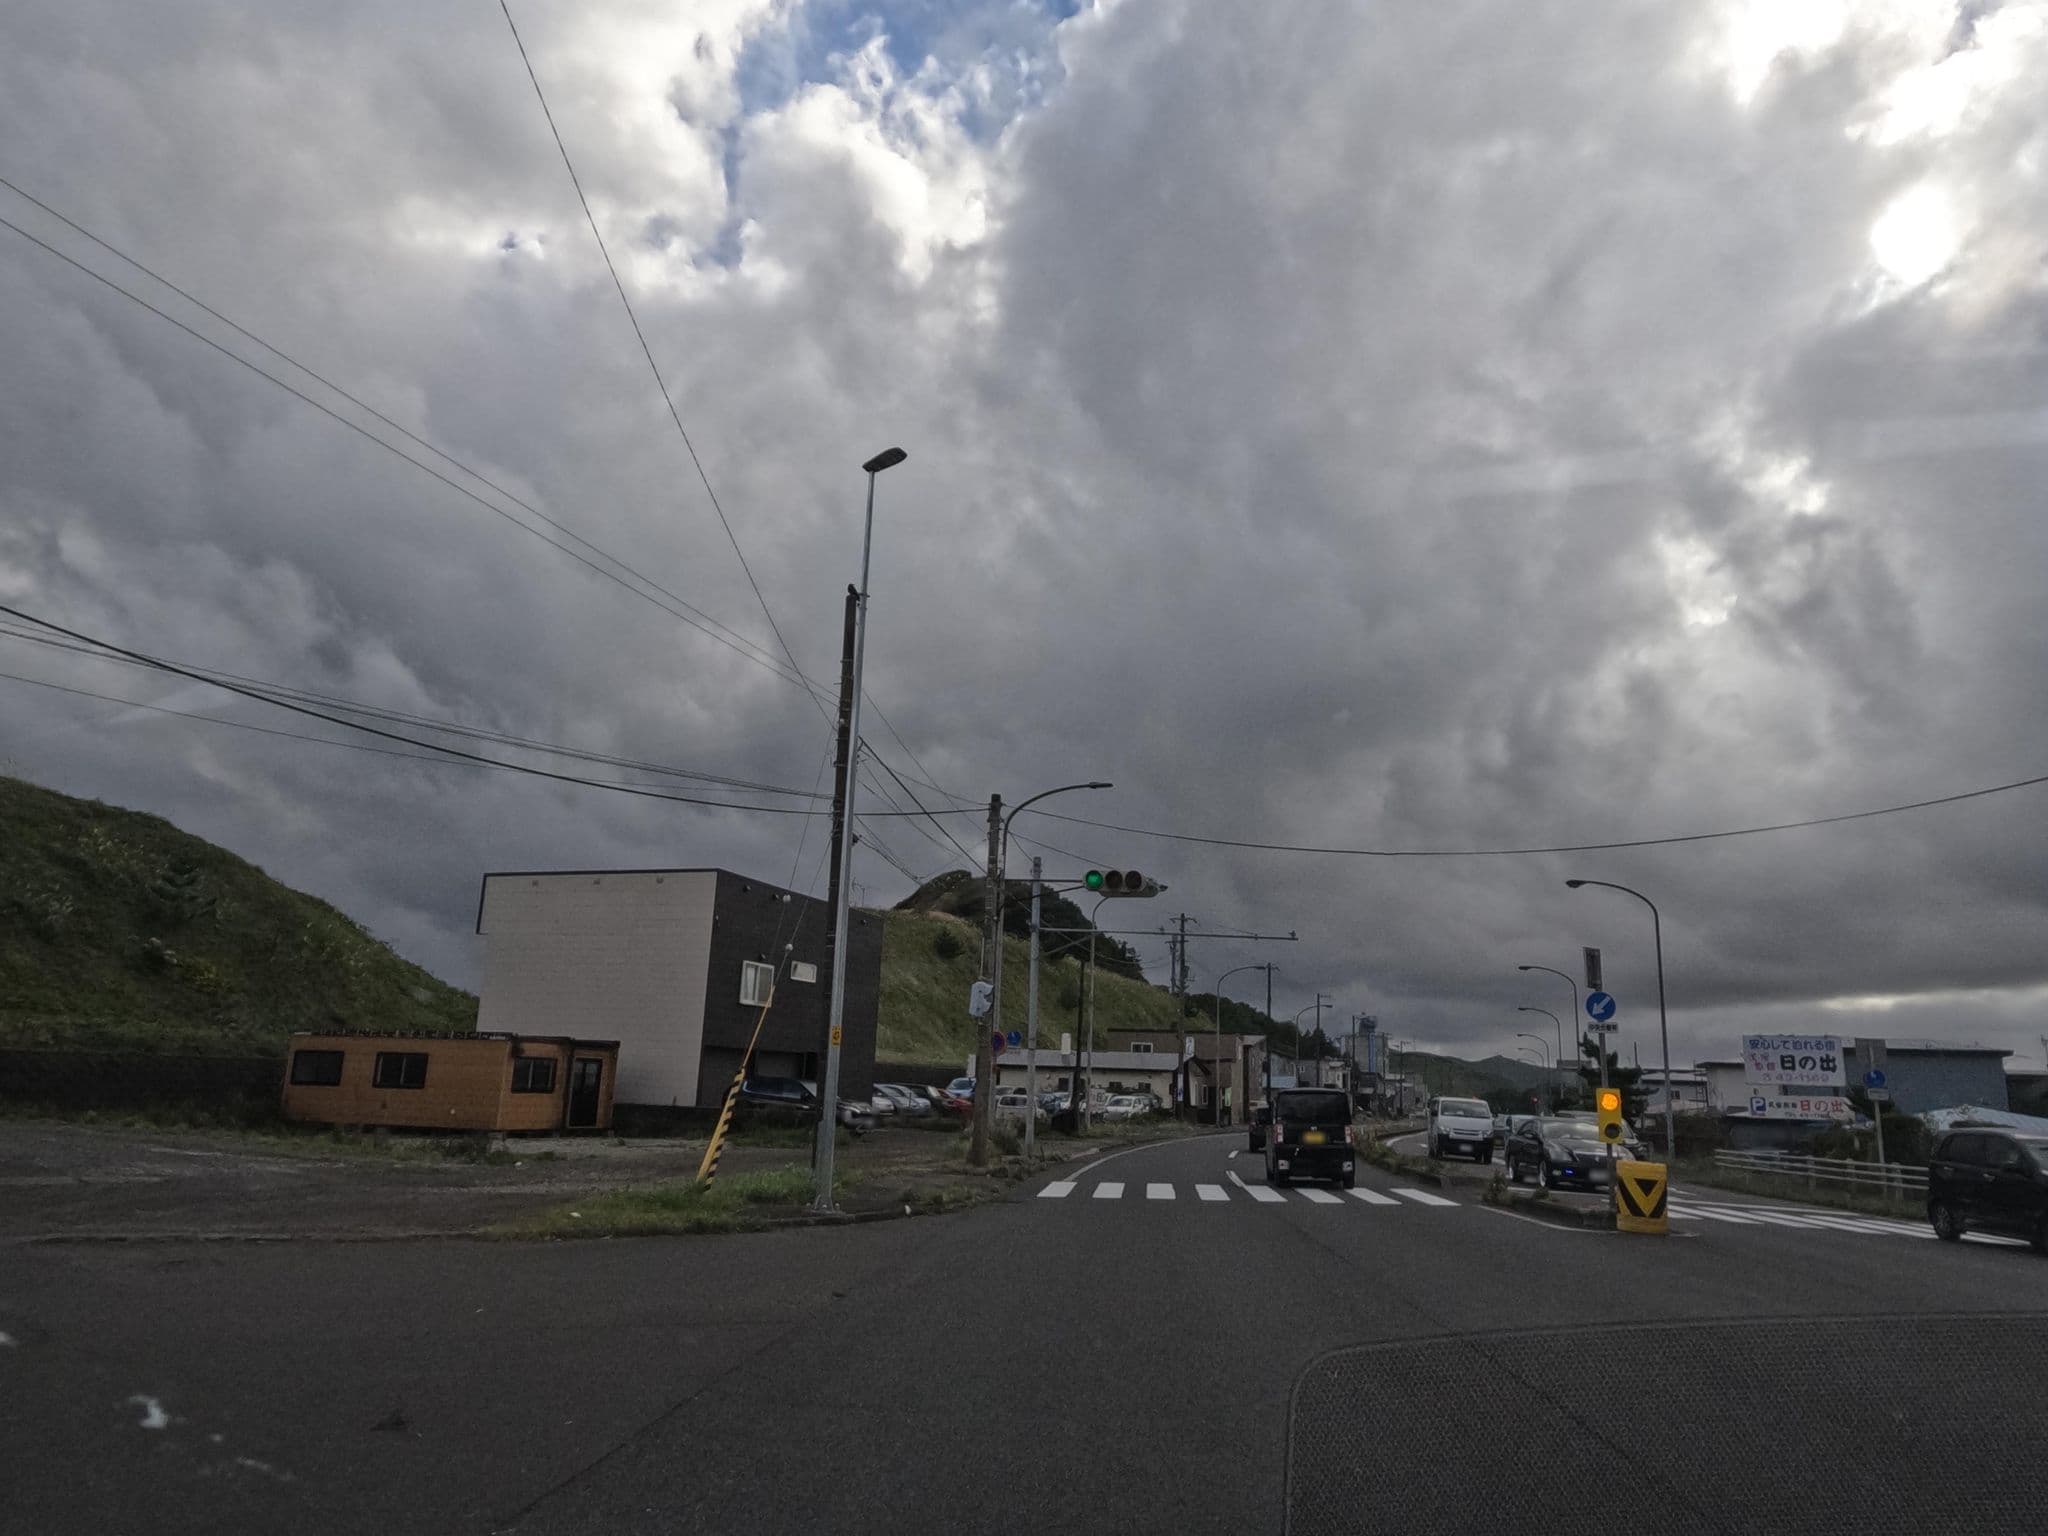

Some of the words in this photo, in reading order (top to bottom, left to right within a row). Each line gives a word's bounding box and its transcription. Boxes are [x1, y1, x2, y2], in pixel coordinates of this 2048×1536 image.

[1780, 1053, 1837, 1073] 日の出
[1752, 1098, 1764, 1111] P
[1800, 1099, 1843, 1113] 日の出
